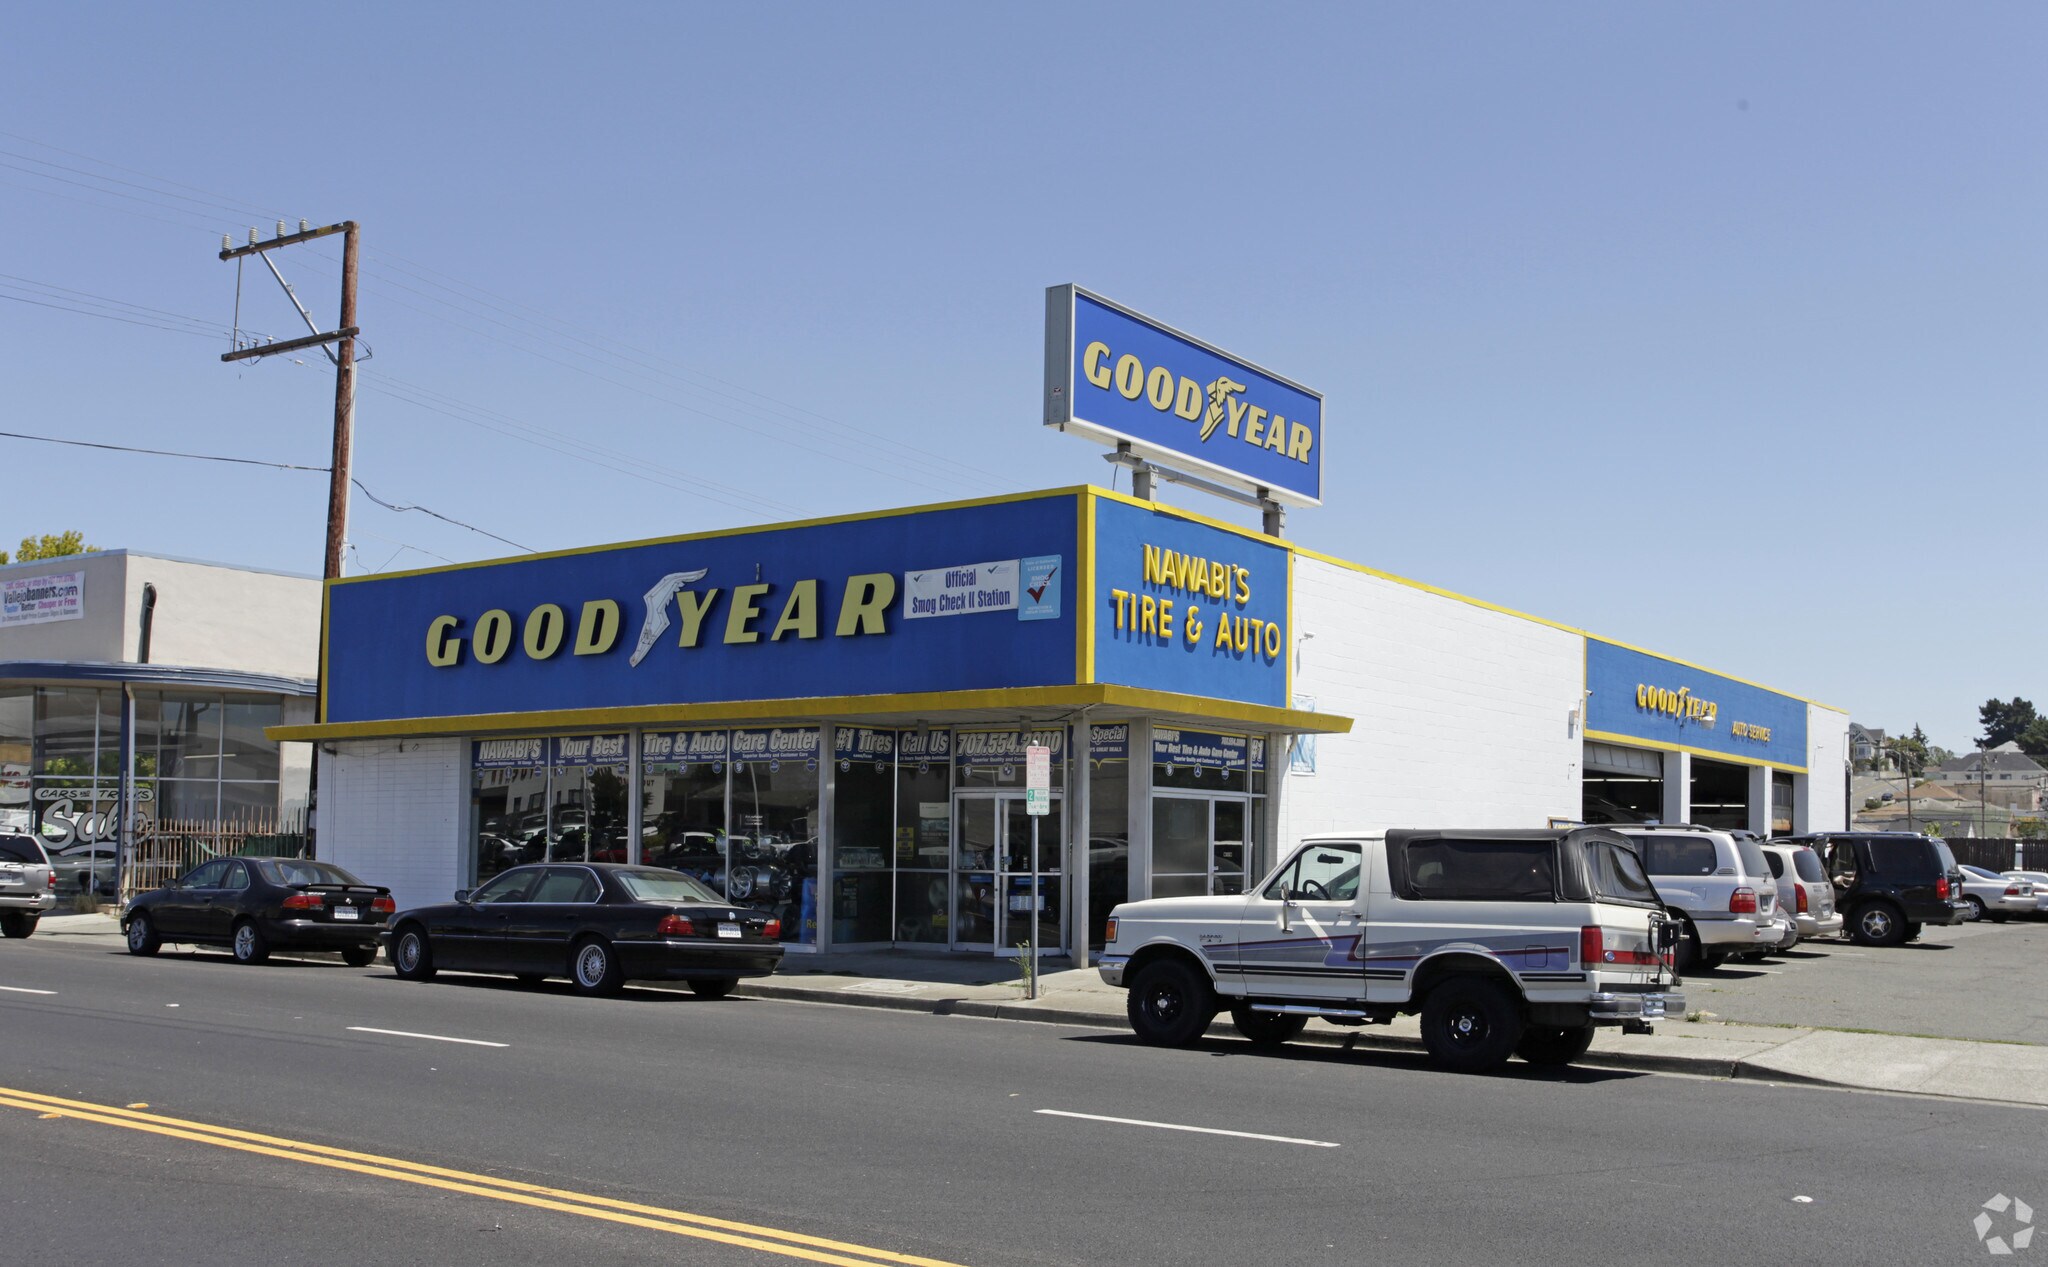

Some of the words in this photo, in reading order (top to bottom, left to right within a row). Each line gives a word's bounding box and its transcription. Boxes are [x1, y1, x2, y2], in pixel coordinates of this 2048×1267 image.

[1083, 341, 1203, 421] GOOD
[1227, 395, 1313, 464] YEAR
[945, 568, 977, 588] Official
[1143, 543, 1250, 604] NAWABI'S
[912, 596, 936, 615] Smog
[939, 593, 966, 612] Check
[977, 589, 1011, 607] Station
[425, 598, 620, 667] GOOD
[676, 571, 896, 648] YEAR
[1112, 588, 1173, 638] TIRE
[1186, 605, 1203, 643] &
[1215, 612, 1281, 658] AUTO
[1637, 683, 1677, 714] GOOD
[479, 739, 542, 761] NAWABI'S
[559, 737, 590, 758] Your
[591, 735, 625, 757] Best
[643, 733, 672, 755] Tire
[673, 732, 687, 754] &
[688, 731, 726, 754] Auto
[731, 729, 767, 753] Care
[769, 728, 820, 752] Center
[836, 728, 854, 752] #1
[858, 729, 893, 754] Tires
[901, 731, 928, 755] Call
[929, 730, 949, 754] Us
[1091, 726, 1127, 744] Special
[1732, 721, 1748, 737] AUTO
[1749, 724, 1771, 742] SERVICE
[1155, 742, 1167, 752] Your
[1168, 743, 1181, 754] Best
[1182, 744, 1193, 755] Tire
[1193, 745, 1198, 755] &
[1198, 746, 1211, 756] Auto
[1223, 748, 1238, 759] Center
[40, 789, 78, 798] CARS
[99, 790, 150, 799] TRKS
[1028, 790, 1033, 801] 2
